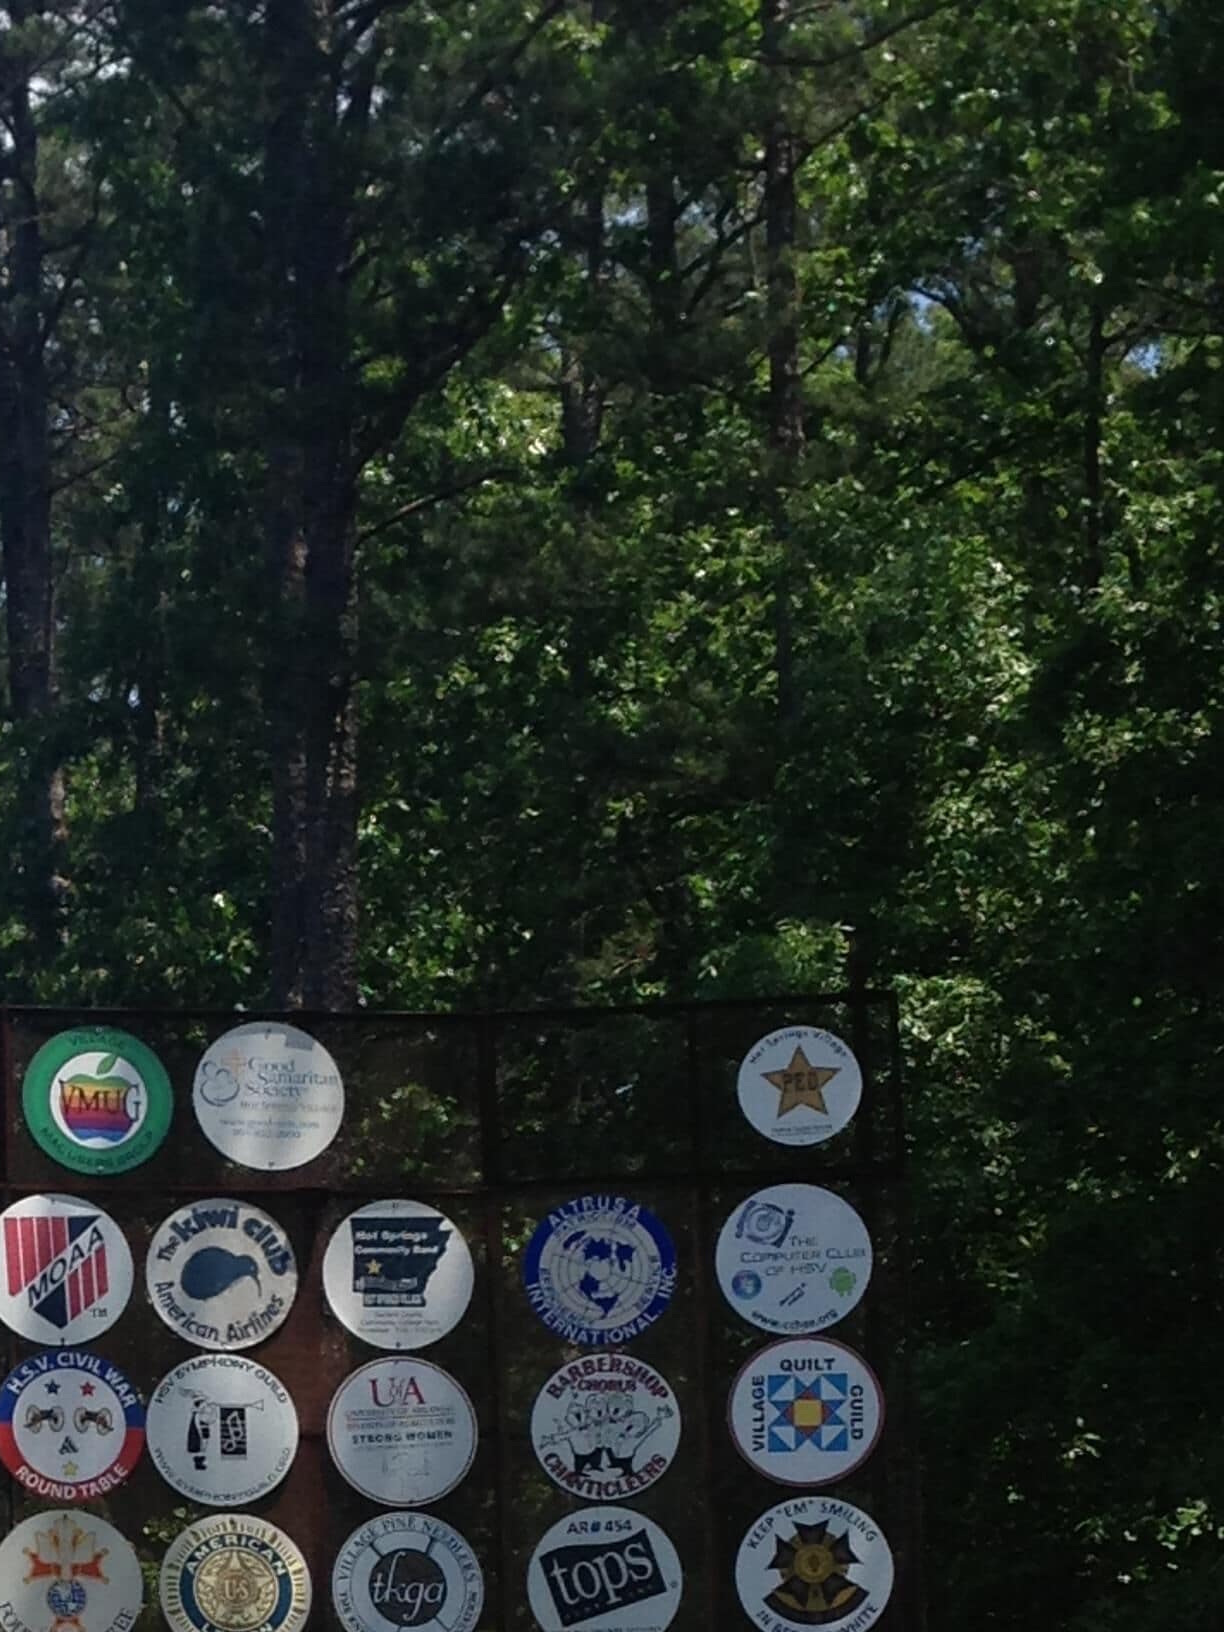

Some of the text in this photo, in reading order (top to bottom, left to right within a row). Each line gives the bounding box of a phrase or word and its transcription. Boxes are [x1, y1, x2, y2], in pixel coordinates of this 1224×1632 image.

[248, 1056, 295, 1073] Good
[548, 1196, 641, 1228] ALTRUSA
[170, 1205, 241, 1244] kiwi
[242, 1217, 294, 1276] club
[740, 1251, 822, 1263] COMPUTER
[29, 1226, 104, 1307] MOAA
[154, 1280, 286, 1342] American Airlines
[6, 1352, 137, 1407] H.S.V. CIVIL WAR
[254, 1369, 288, 1404] GUILD
[546, 1353, 669, 1400] BARBERSHOP
[575, 1378, 637, 1393] CHORUS
[779, 1357, 836, 1373] QUILT
[751, 1375, 766, 1452] VILLAGE
[850, 1385, 865, 1440] GUILD
[15, 1466, 77, 1499] ROUND
[79, 1465, 129, 1497] TABLE
[543, 1451, 668, 1498] CHANTICLEERS
[337, 1527, 377, 1581] VILLAGE
[382, 1516, 417, 1531] PINE
[746, 1502, 878, 1551] KEEP SMILING
[187, 1532, 288, 1576] AMERICAN
[550, 1541, 654, 1607] tops
[756, 1609, 771, 1627] IN
